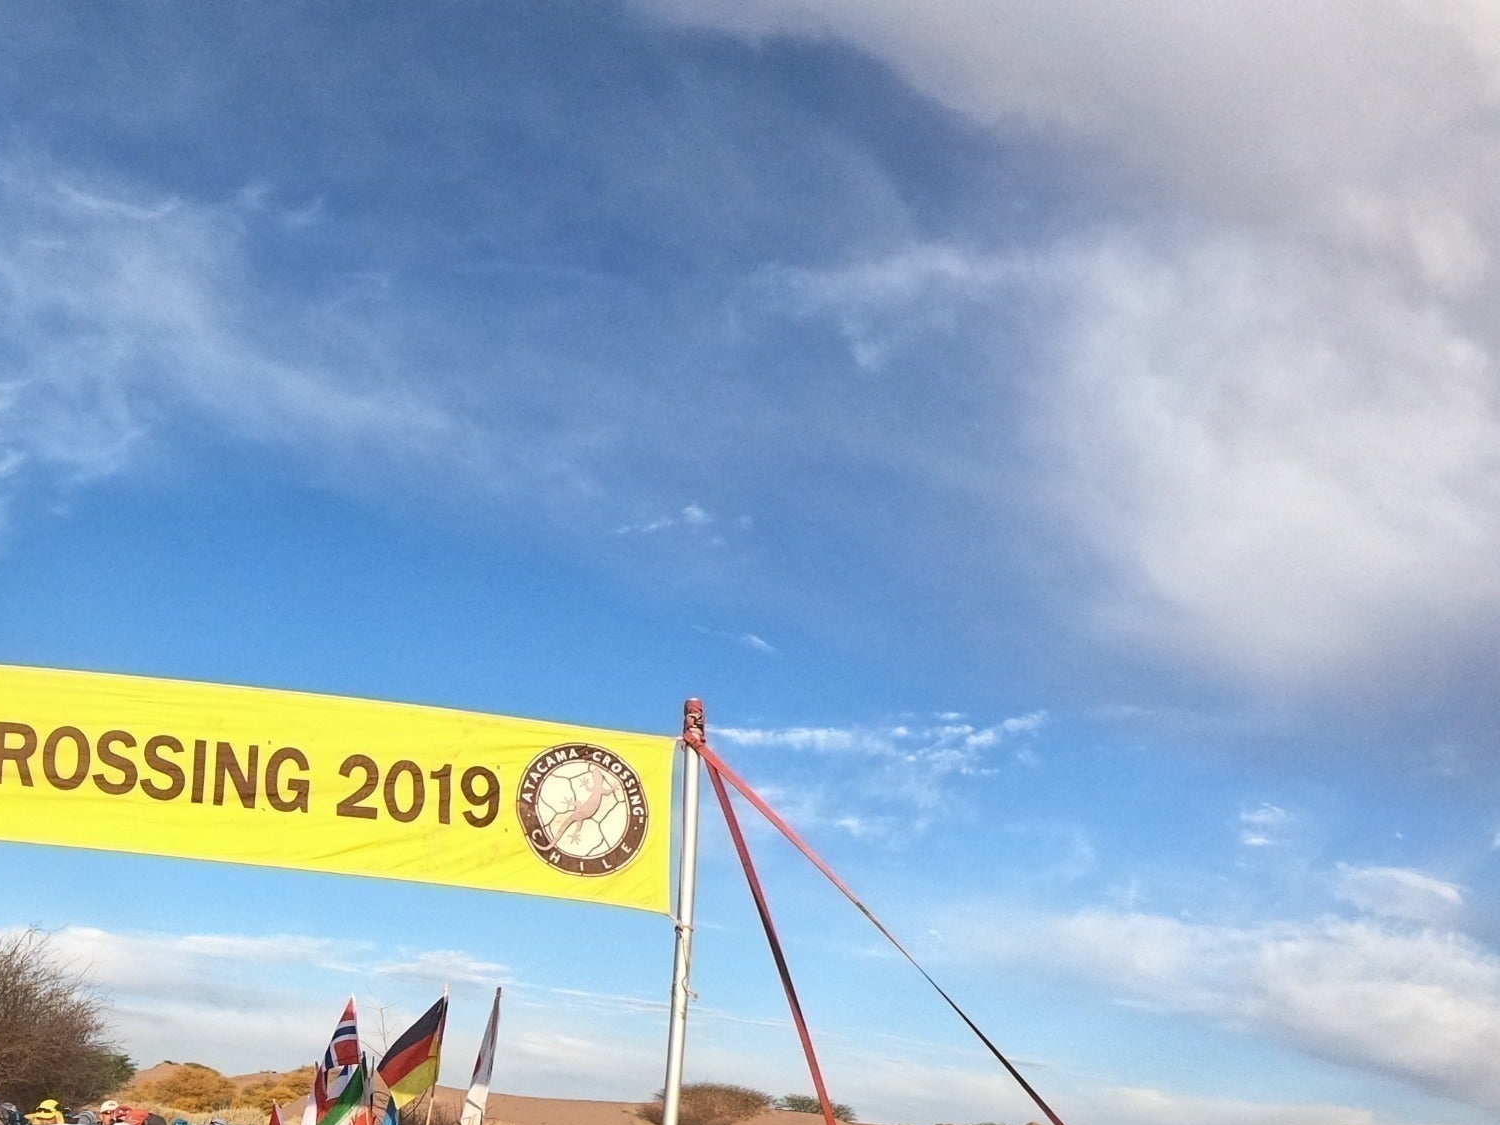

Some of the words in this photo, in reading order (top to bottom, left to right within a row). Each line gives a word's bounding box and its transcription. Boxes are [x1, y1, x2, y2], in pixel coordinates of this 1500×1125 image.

[335, 753, 501, 829] 2019
[521, 747, 580, 804] ATACAMA
[591, 751, 645, 817] CROSSING
[531, 828, 633, 872] CHILE
